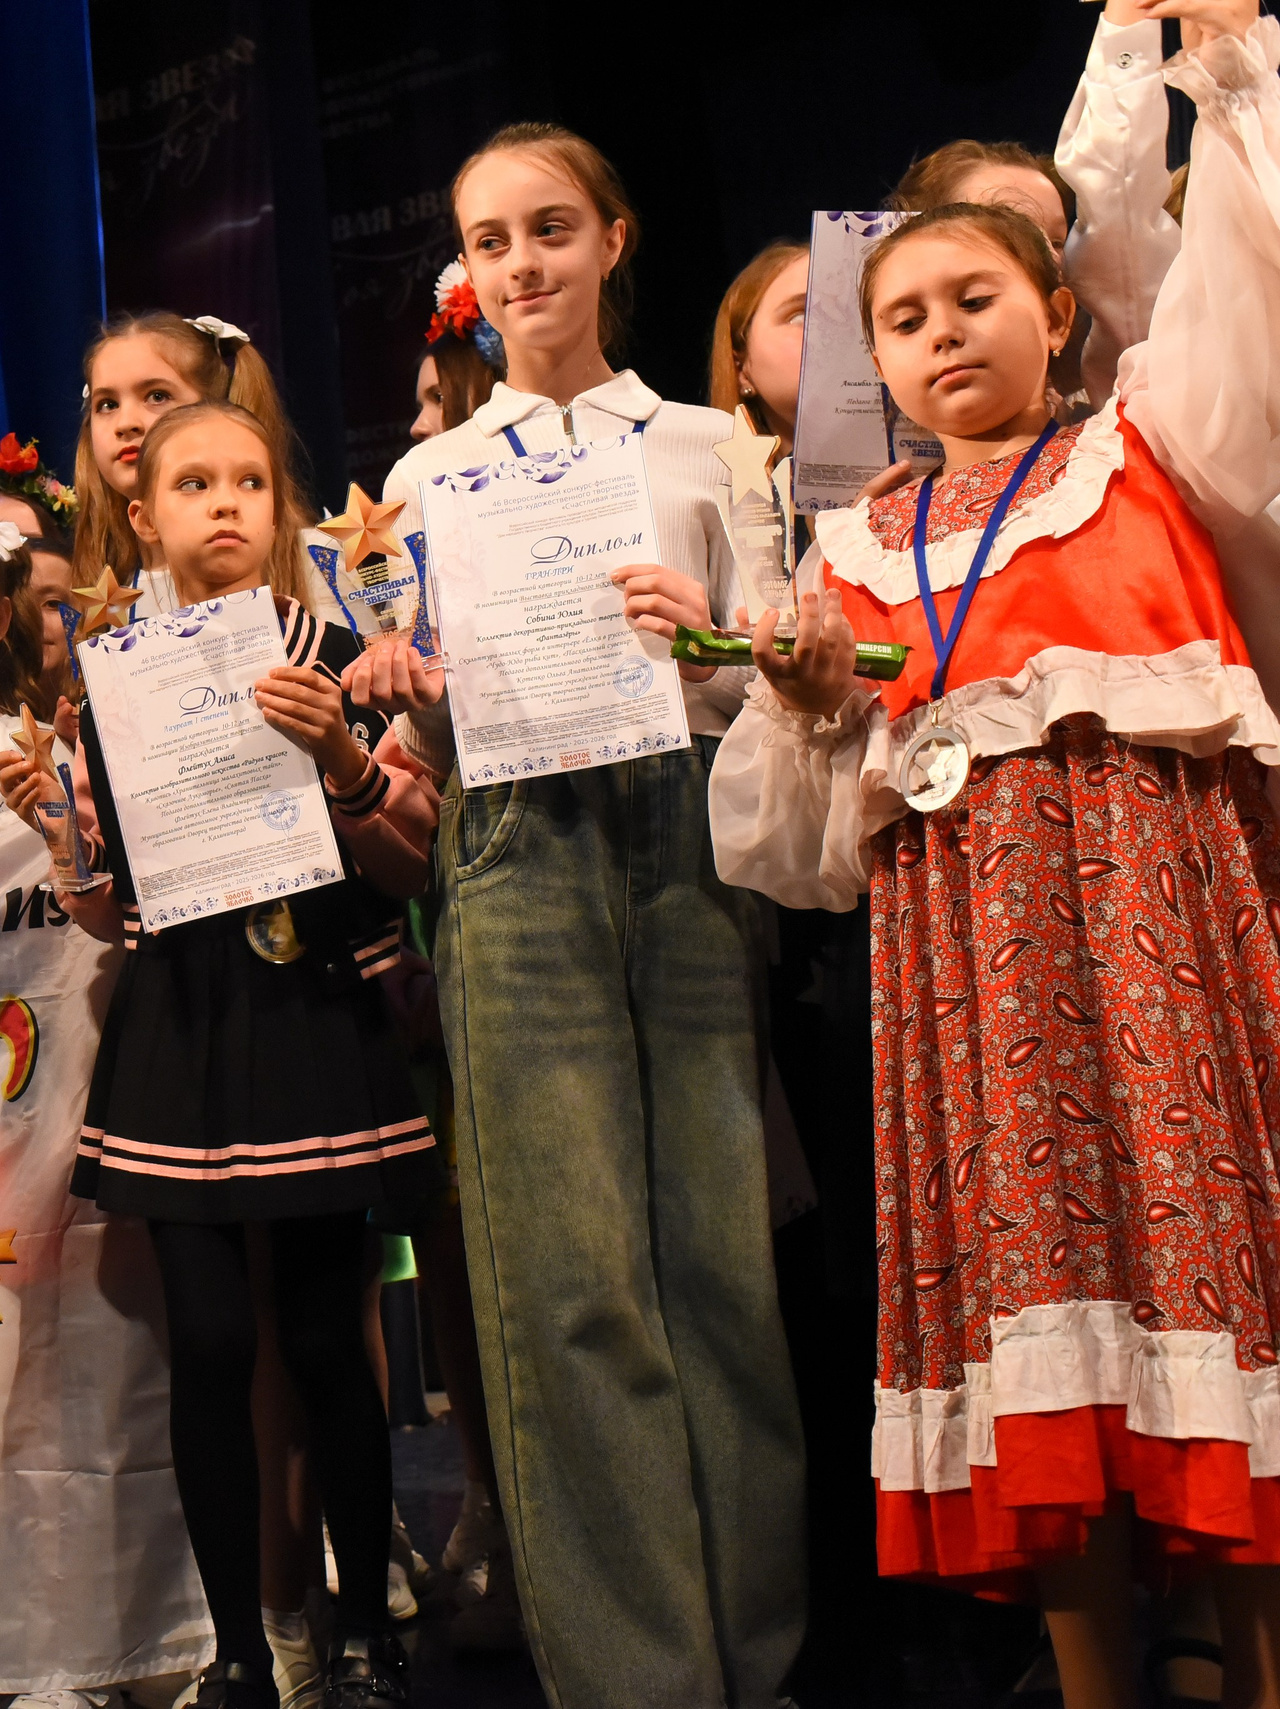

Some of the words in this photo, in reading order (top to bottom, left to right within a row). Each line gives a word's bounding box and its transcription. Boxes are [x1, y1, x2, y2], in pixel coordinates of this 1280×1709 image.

[834, 408, 884, 416] Концертмейсте
[477, 490, 590, 518] музыкально-художественного
[592, 481, 636, 495] творчества
[492, 499, 502, 507] 46
[503, 488, 561, 505] Всероссийский
[561, 494, 608, 510] «Счастливая
[610, 489, 639, 499] звезда»
[530, 532, 642, 565] Диплом
[524, 564, 574, 580] ГРАН-ПРИ
[348, 576, 415, 601] СЧАСТЛИВАЯ
[499, 583, 537, 596] возрастной
[537, 579, 572, 590] категории
[575, 573, 593, 583] 10-12
[593, 571, 607, 580] лет
[365, 589, 403, 606] ЗВЕЗДА
[481, 597, 518, 608] номинации
[553, 584, 594, 597] прикладного
[523, 597, 582, 612] награждается
[525, 613, 556, 625] Собина
[557, 608, 583, 619] Юлия
[475, 632, 512, 643] Коллектив
[513, 617, 597, 636] декоративно-прикладного
[129, 642, 228, 677] музыкально-художественного
[229, 631, 270, 646] творчества
[140, 657, 149, 665] 46
[150, 641, 201, 662] Всероссийский
[458, 653, 498, 665] Скульптура
[546, 639, 580, 650] интерьере
[855, 642, 892, 656] НИКЕРСНИ
[498, 668, 524, 677] Педагог
[525, 658, 581, 672] дополнительного
[515, 674, 545, 684] Котенко
[546, 670, 566, 679] Ольга
[567, 662, 610, 675] Анатольевна
[478, 686, 526, 699] Муниципальное
[564, 674, 598, 686] учреждение
[178, 686, 256, 717] Дипл
[550, 691, 590, 705] Калининград
[200, 709, 229, 722] степени
[221, 719, 238, 731] 10-12
[178, 743, 229, 762] награждается
[527, 742, 568, 753] Калининград
[573, 734, 605, 746] 2025-2026
[210, 753, 235, 767] Алиса
[129, 786, 159, 799] Коллектив
[159, 771, 210, 790] изобразительного
[210, 762, 240, 775] искусства
